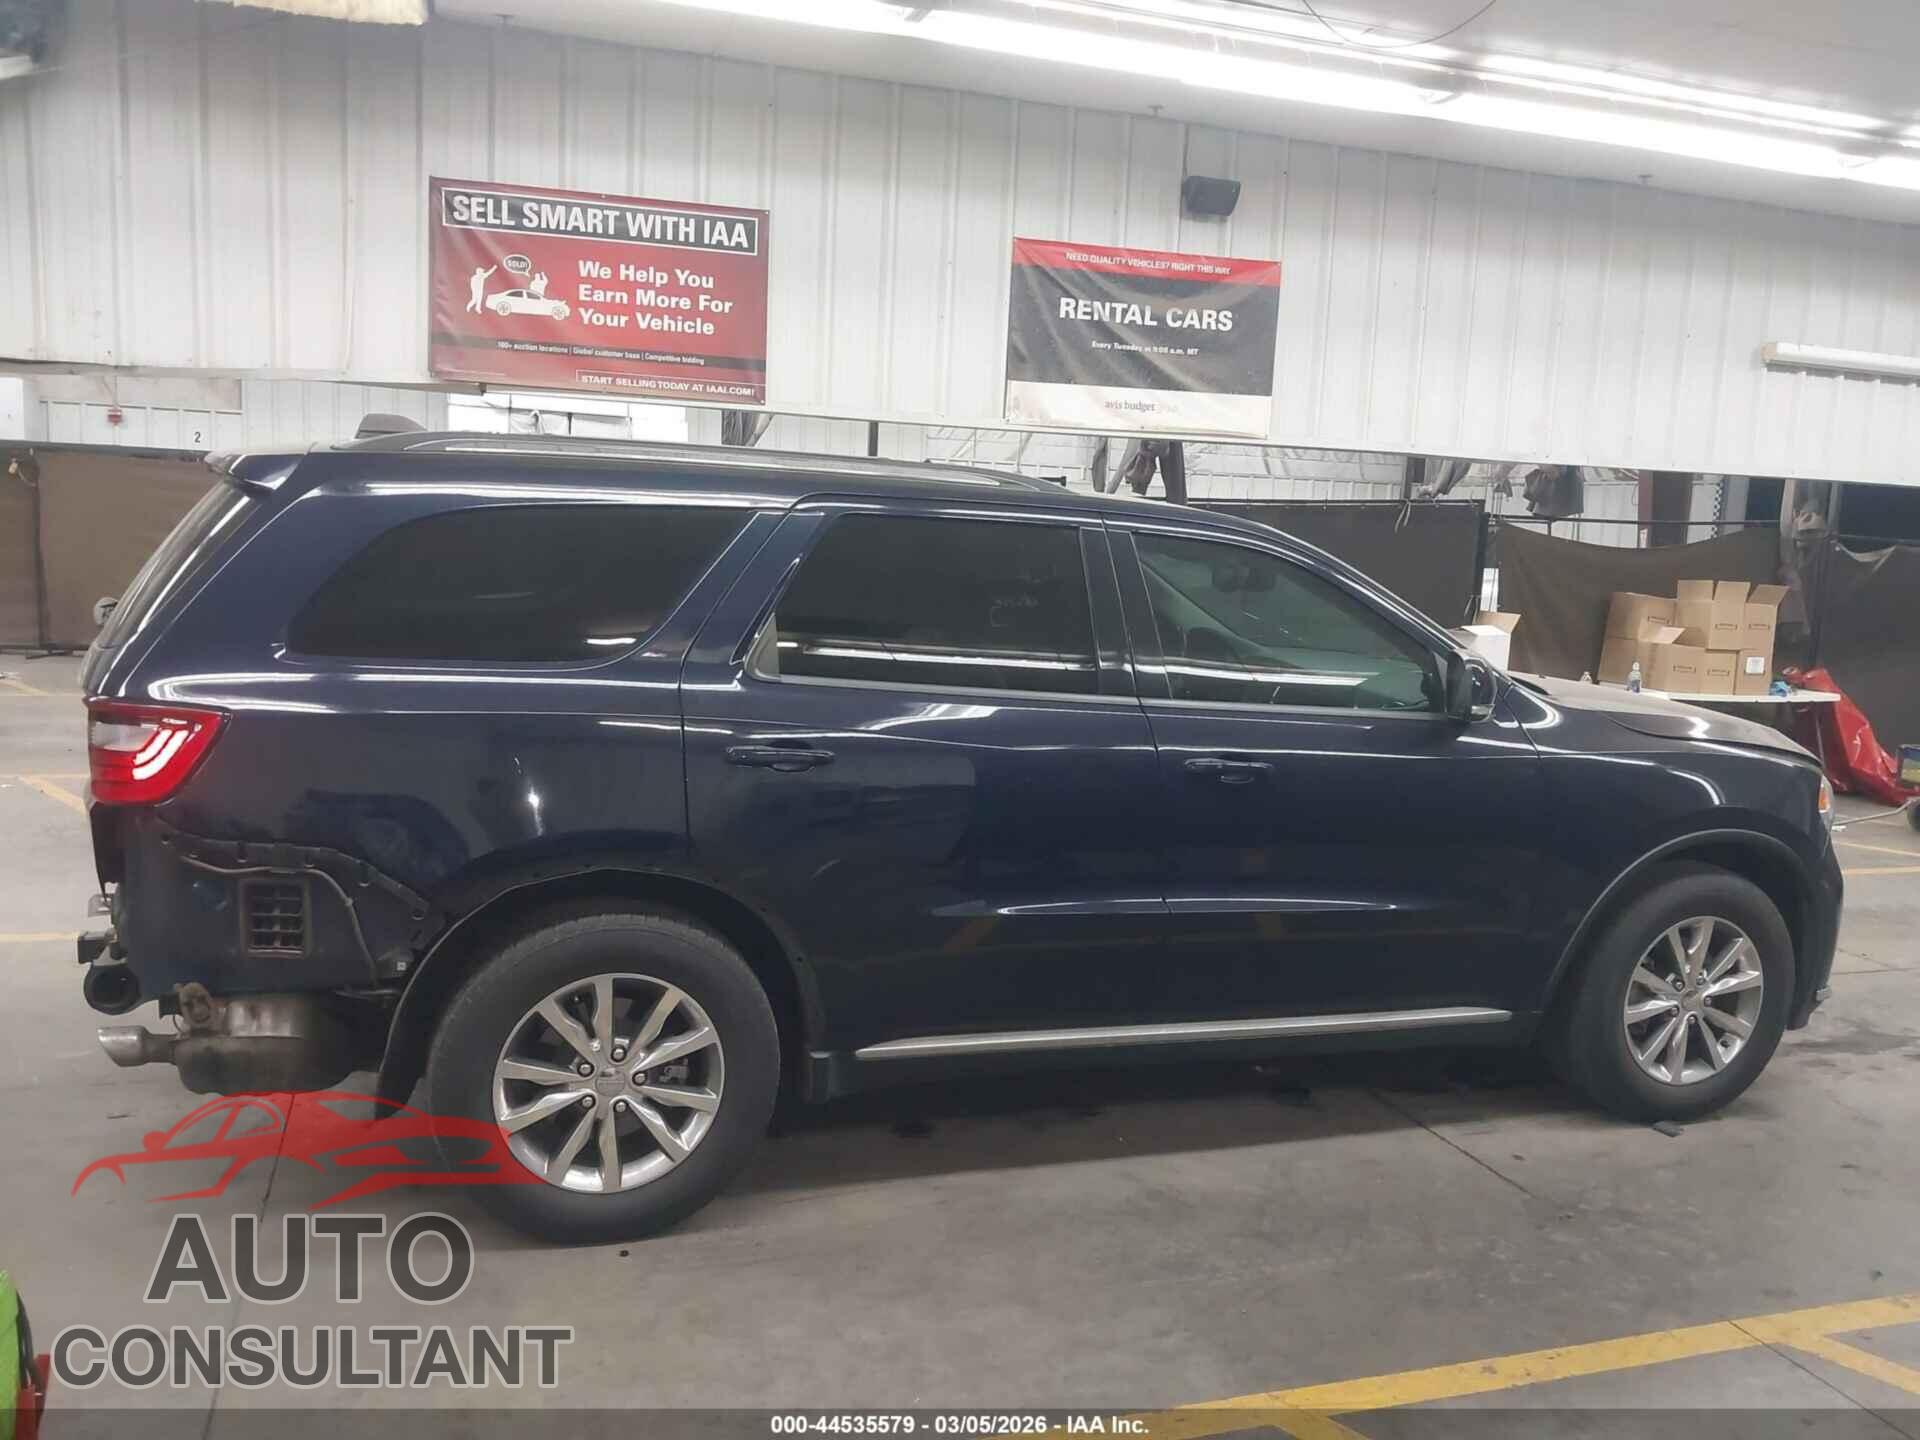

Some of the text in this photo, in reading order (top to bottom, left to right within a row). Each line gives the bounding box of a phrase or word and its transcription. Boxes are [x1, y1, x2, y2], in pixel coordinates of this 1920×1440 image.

[453, 195, 749, 248] SELL SMART WITH IAA
[578, 259, 715, 289] We Help You
[1065, 252, 1089, 262] NEED
[1090, 255, 1127, 265] QUALITY
[1127, 258, 1170, 270] VEHICLES?
[1171, 262, 1196, 273] RIGHT
[1197, 264, 1214, 274] THIS
[578, 284, 733, 314] Earn More For
[579, 308, 715, 335] Your Vehicle
[1058, 297, 1234, 331] RENTAL CARS
[514, 342, 538, 351] auction
[539, 344, 568, 354] locations
[573, 346, 594, 355] Global
[594, 349, 624, 358] customer
[625, 350, 641, 359] base
[645, 352, 681, 364] Competitive
[682, 355, 705, 366] bidding
[1091, 340, 1112, 351] Every
[1113, 342, 1143, 353] Tuesday
[581, 375, 756, 396] START SELLING TODAY AT IAAI.COM!
[1104, 400, 1122, 409] avis
[1124, 400, 1156, 413] budget
[194, 431, 201, 443] 2
